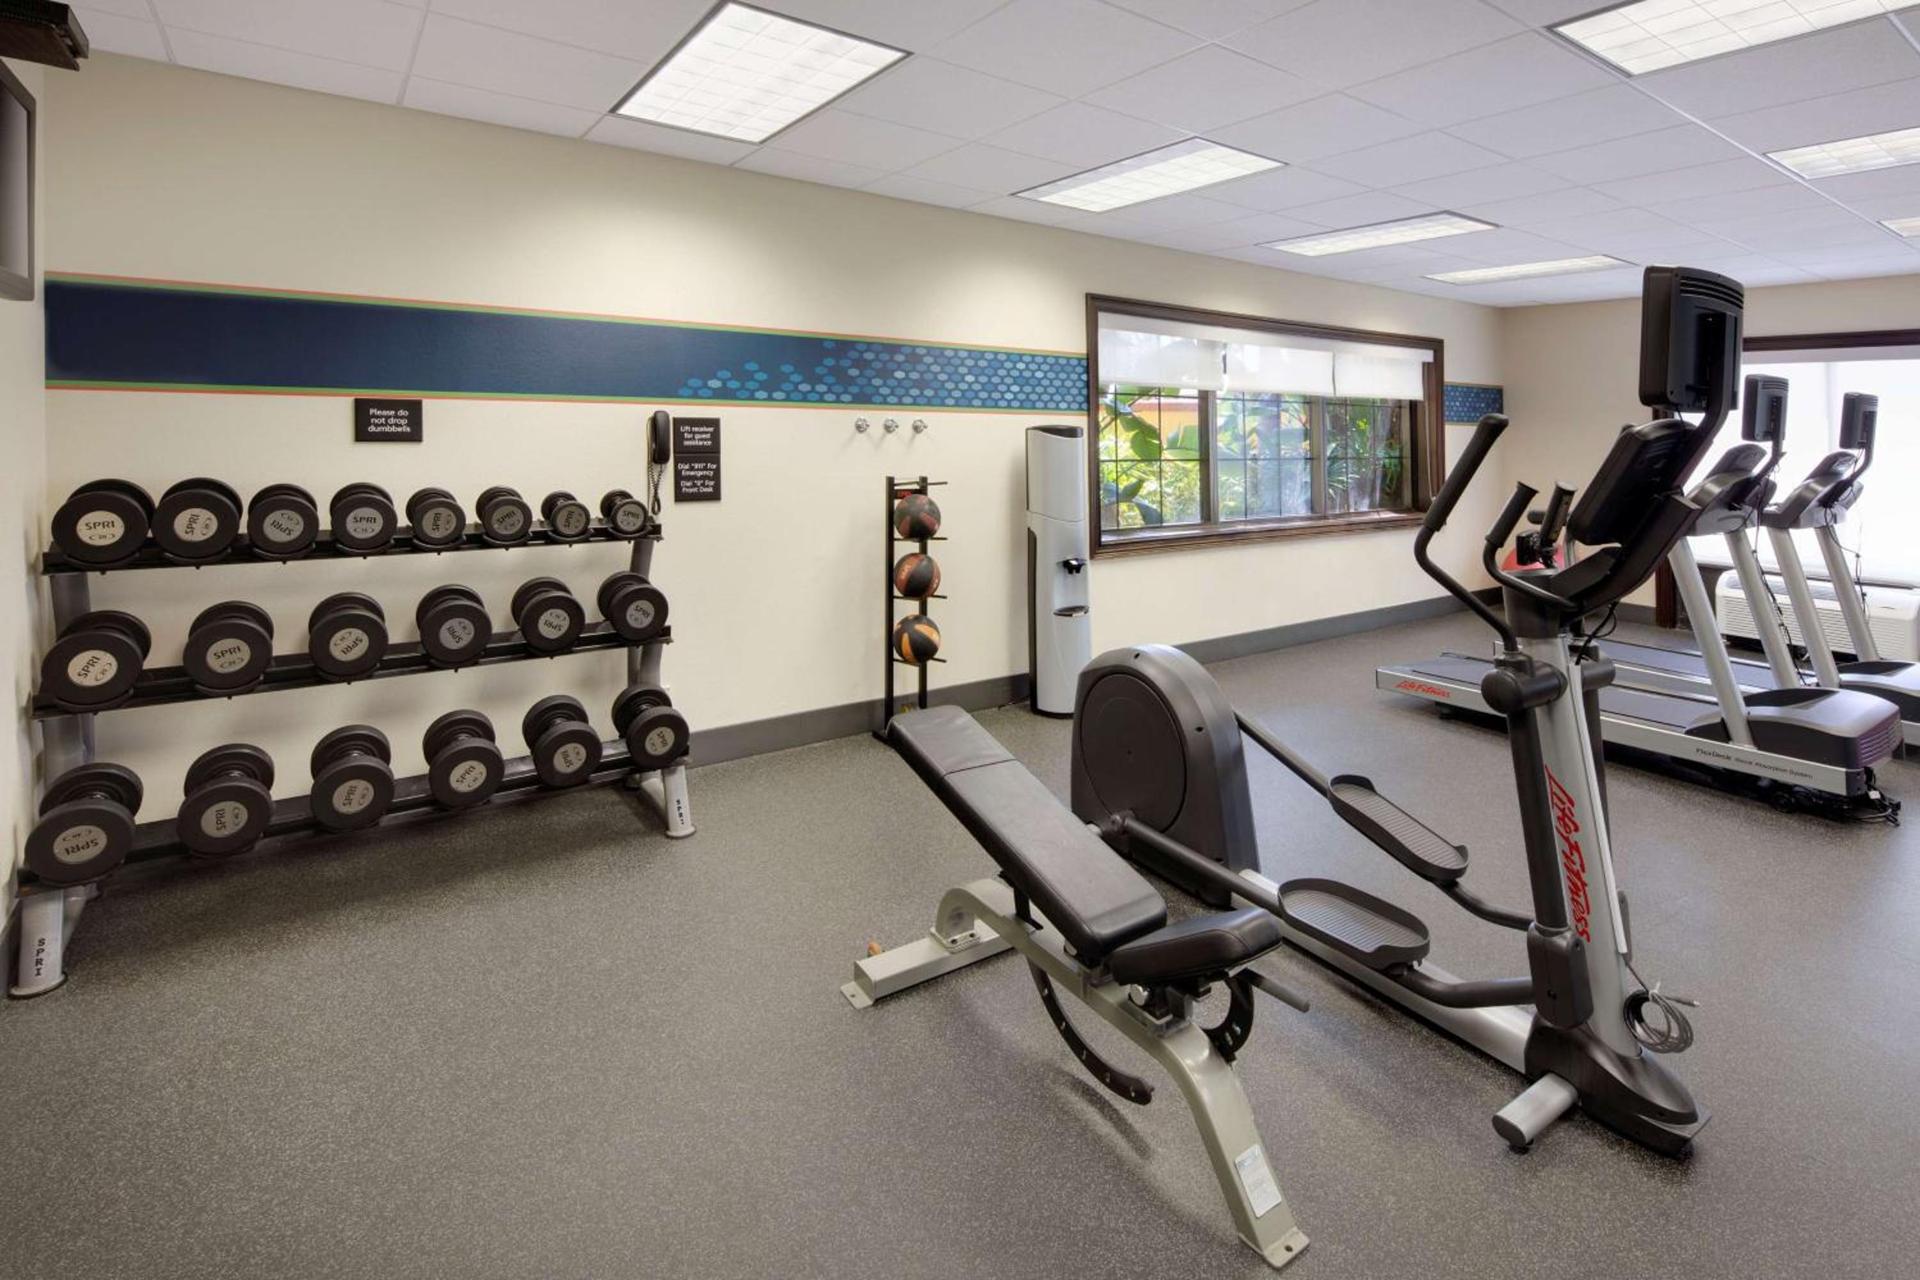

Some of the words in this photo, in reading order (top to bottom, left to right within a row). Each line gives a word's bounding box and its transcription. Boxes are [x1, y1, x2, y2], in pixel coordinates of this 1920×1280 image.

[369, 407, 396, 417] Please
[397, 408, 409, 417] do
[387, 416, 408, 426] drop
[367, 424, 411, 433] dumbbells
[681, 469, 714, 477] Emergency
[85, 520, 115, 530] SPRI
[184, 513, 200, 535] SPRI
[270, 519, 294, 536] SPRI
[213, 645, 241, 660] SPRI
[340, 636, 363, 655] SPRI
[77, 655, 100, 678] SPRI
[342, 785, 358, 806] SPRI
[1544, 764, 1580, 834] Life
[215, 808, 226, 831] SPRI
[64, 837, 99, 856] SPRI
[1557, 827, 1592, 943] Fitness
[34, 938, 46, 977] SPRI
